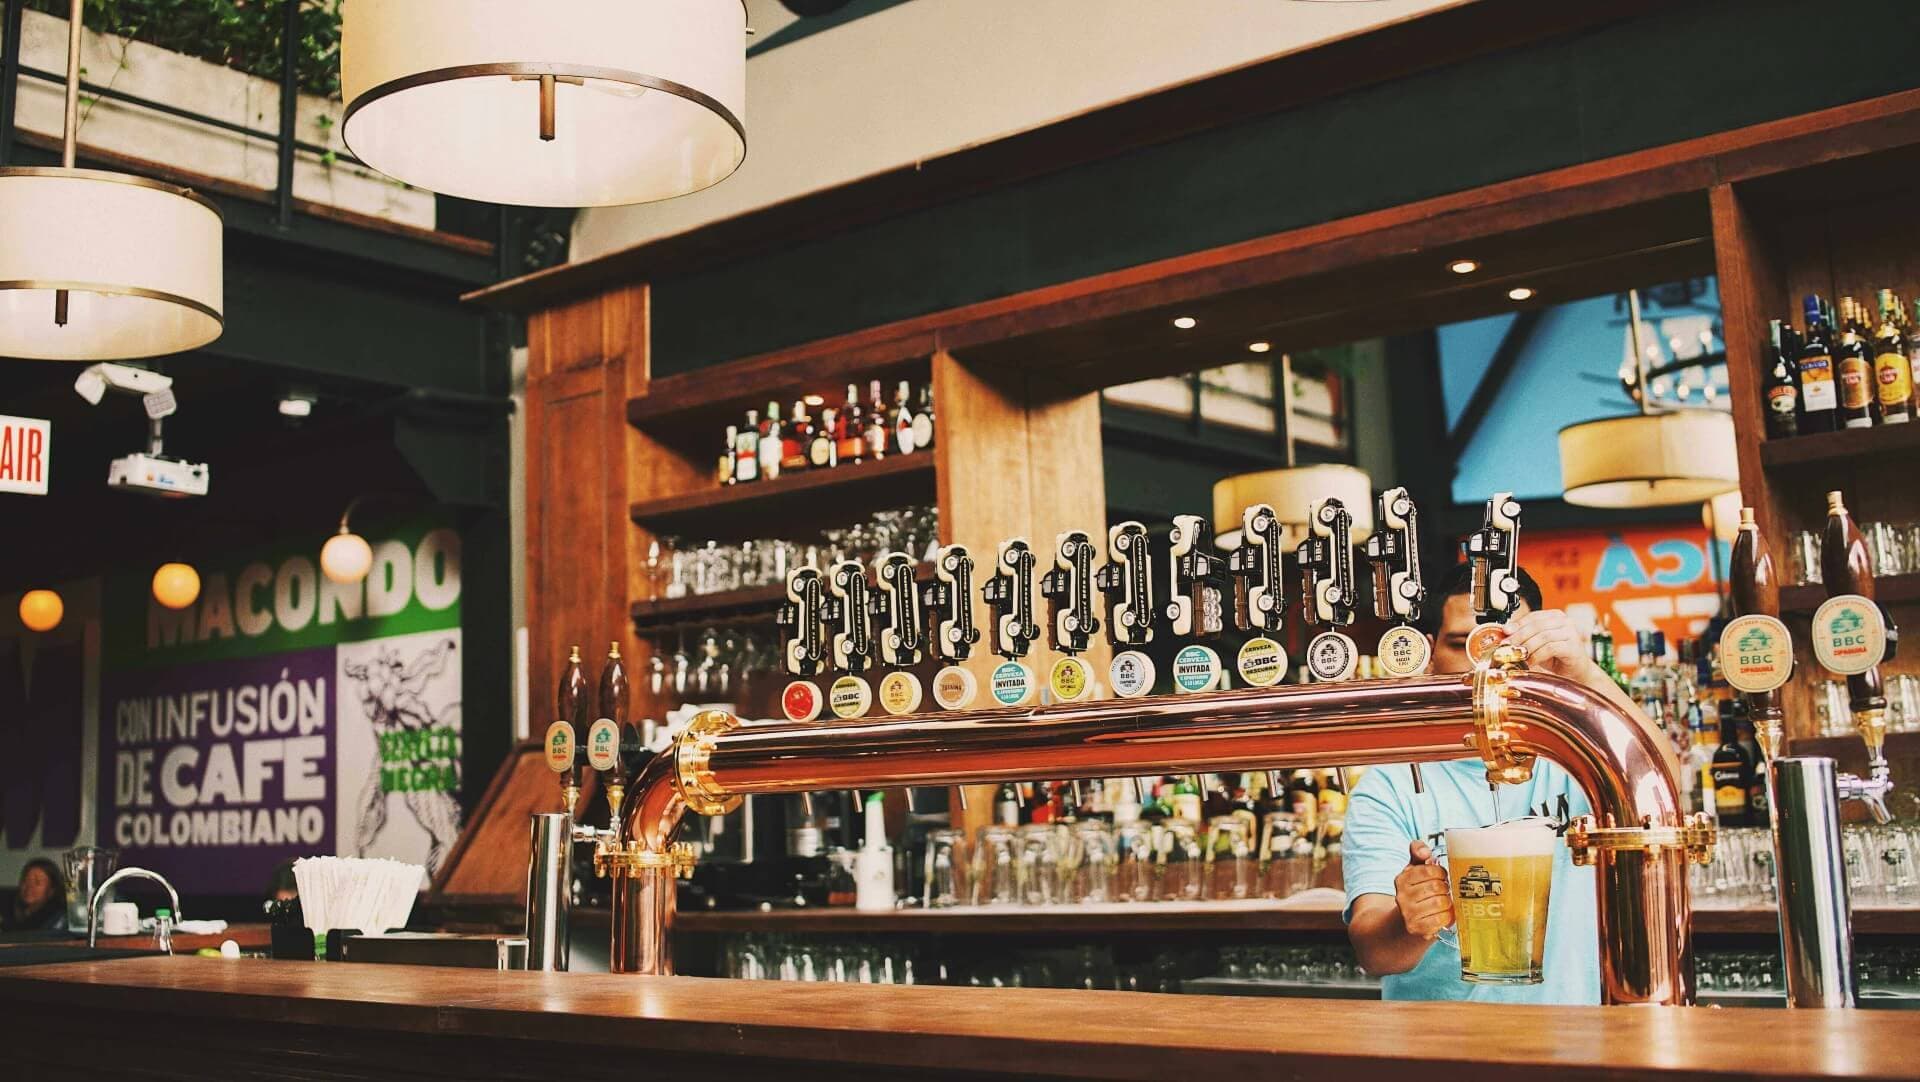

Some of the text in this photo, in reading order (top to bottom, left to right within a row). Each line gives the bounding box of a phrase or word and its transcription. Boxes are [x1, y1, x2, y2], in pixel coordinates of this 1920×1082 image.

[0, 426, 42, 482] AIR
[1314, 540, 1322, 562] BBC
[1386, 533, 1395, 554] BBC
[1247, 548, 1255, 569] BBC
[1832, 634, 1865, 648] BBC
[1255, 655, 1277, 666] BBC
[1393, 649, 1412, 657] BBC
[1740, 654, 1773, 665] BBC
[1178, 664, 1210, 674] INVITADA
[995, 678, 1026, 689] INVITADA
[842, 692, 860, 701] BBC
[116, 668, 327, 744] CON INFUSIÓN
[116, 752, 155, 807] DE
[116, 806, 325, 846] COLOMBIANO
[1462, 902, 1503, 917] BBC
